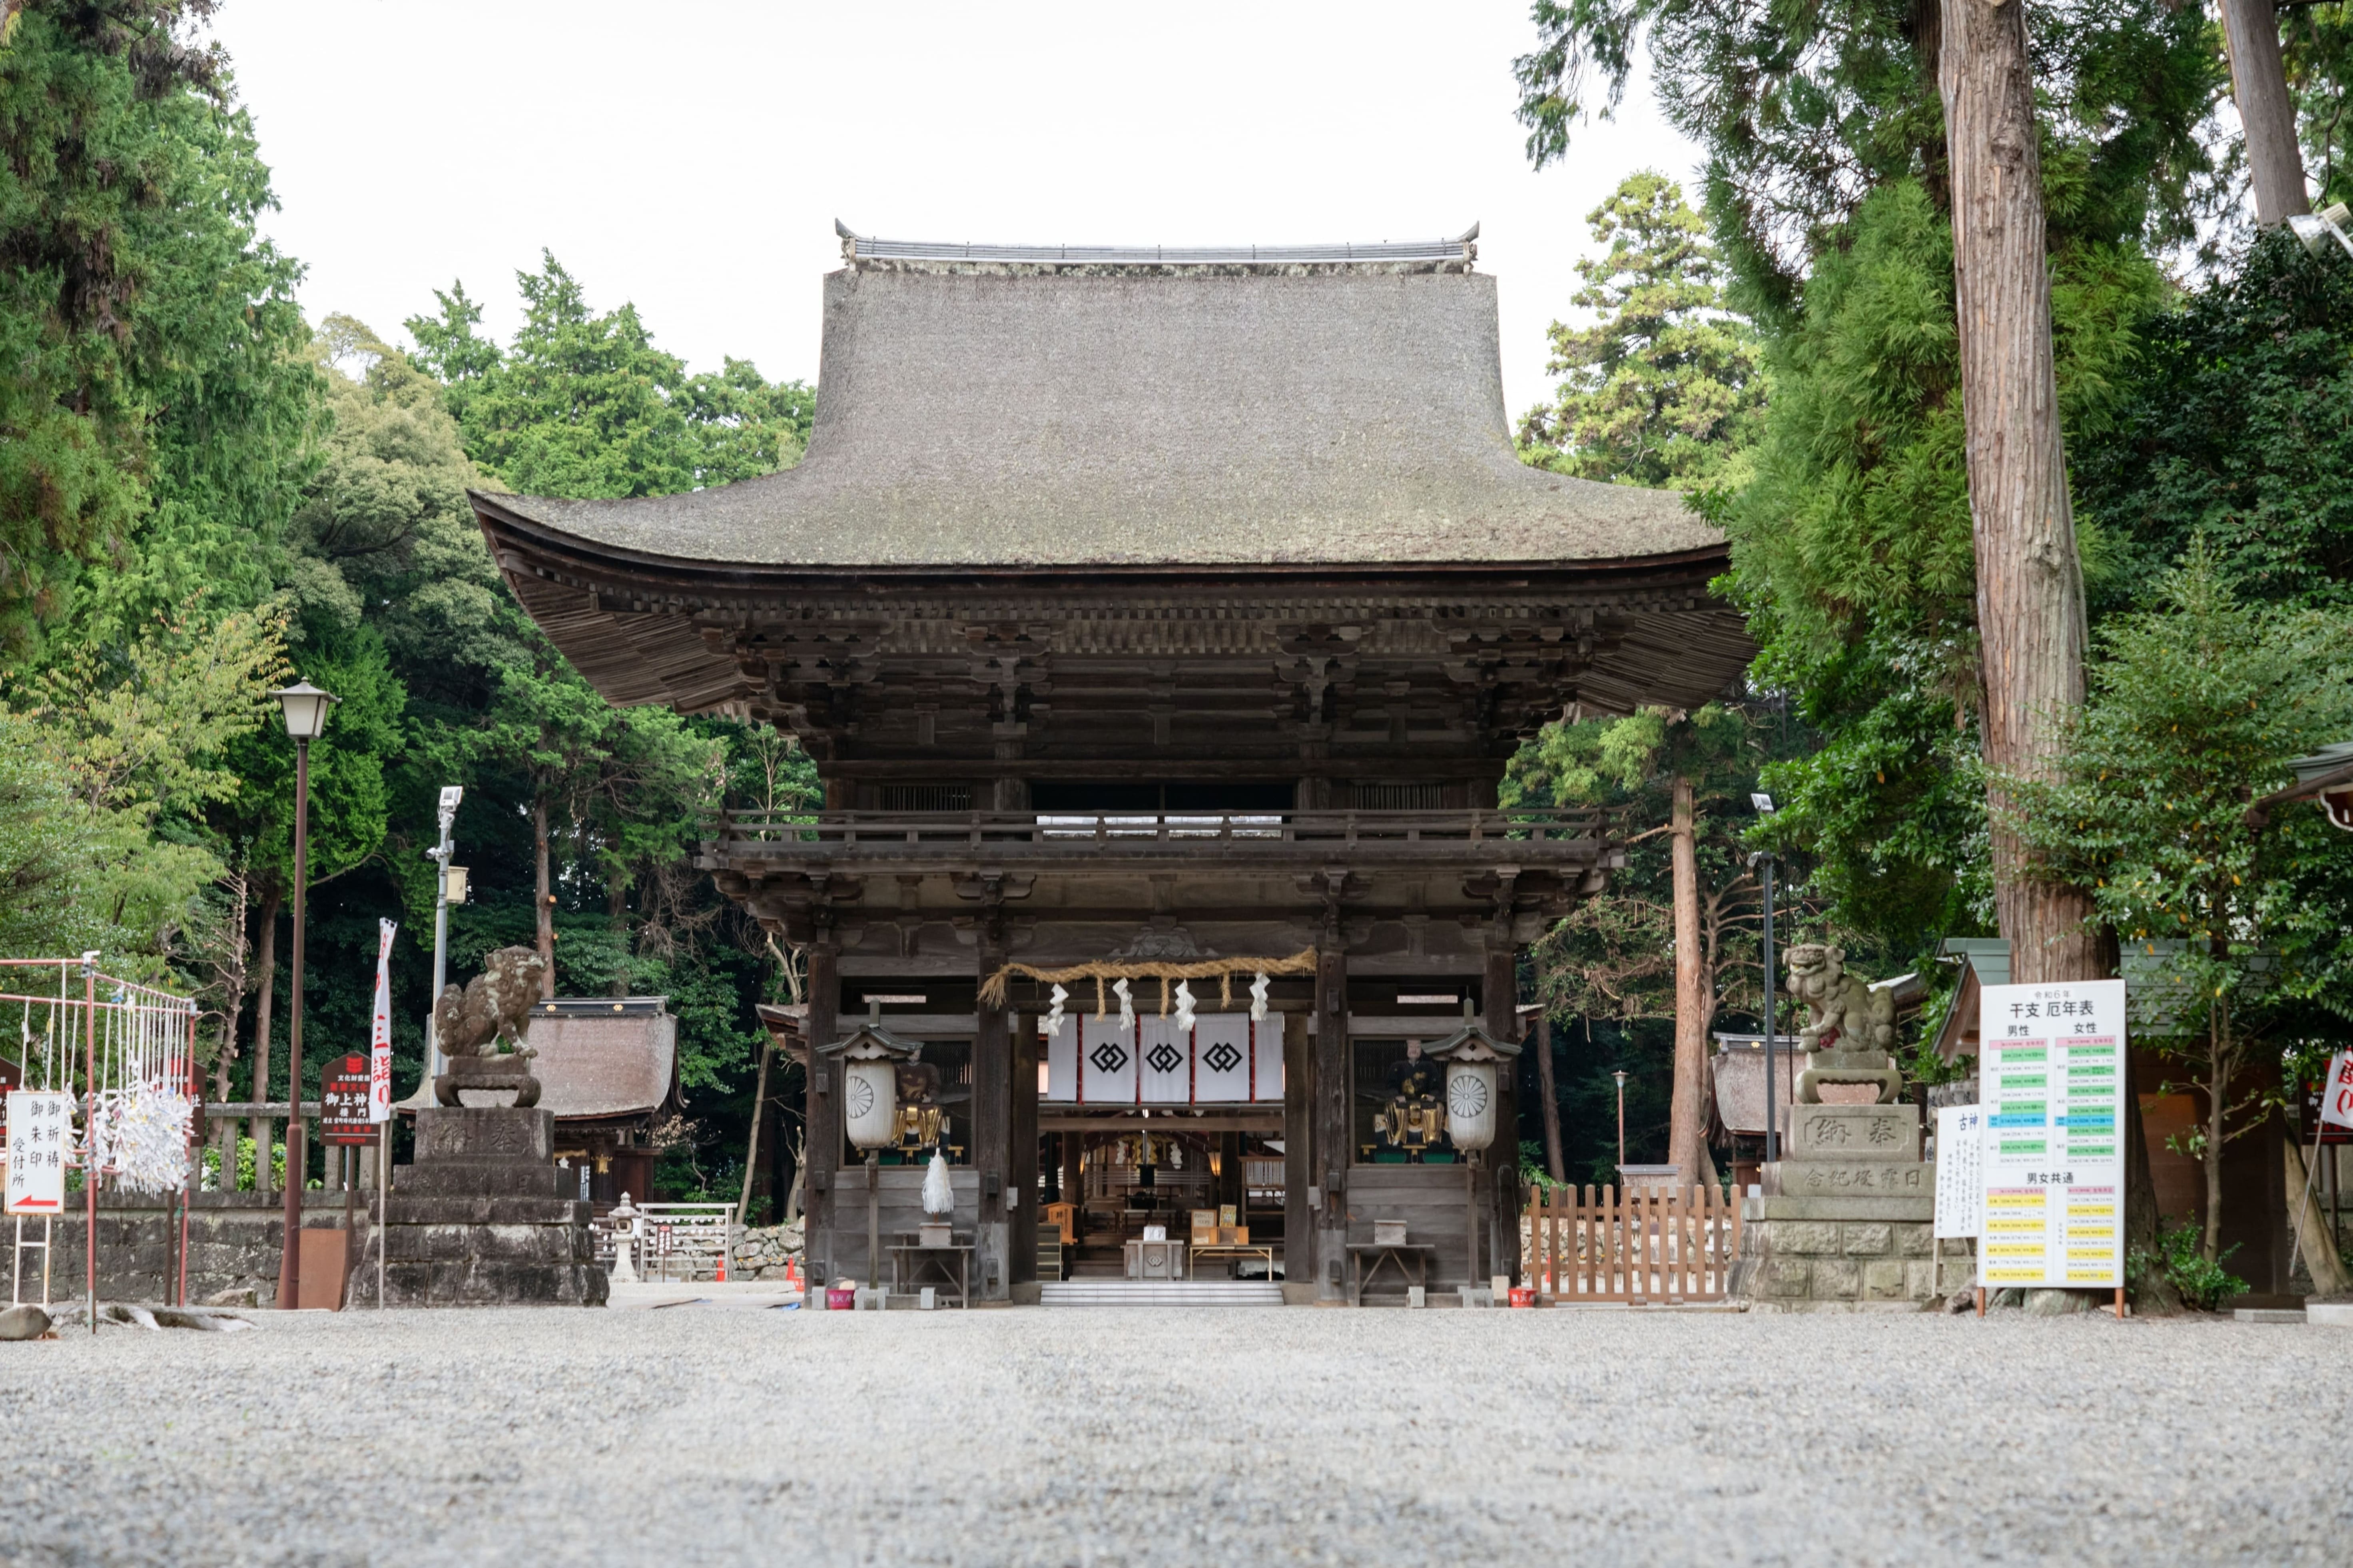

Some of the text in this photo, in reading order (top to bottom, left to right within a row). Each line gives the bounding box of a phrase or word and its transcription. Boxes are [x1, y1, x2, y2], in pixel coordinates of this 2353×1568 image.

[2034, 990, 2071, 999] 令和6年
[2010, 1000, 2094, 1018] 干支 厄年表
[2007, 1024, 2030, 1037] 男性
[2074, 1022, 2097, 1034] 女性
[325, 1092, 370, 1107] 御上神
[1959, 1112, 1978, 1131] 古神
[30, 1100, 43, 1168] 御朱印
[47, 1100, 60, 1168] 御祈祷
[12, 1137, 25, 1189] 受付所
[2027, 1172, 2074, 1185] 男女共通
